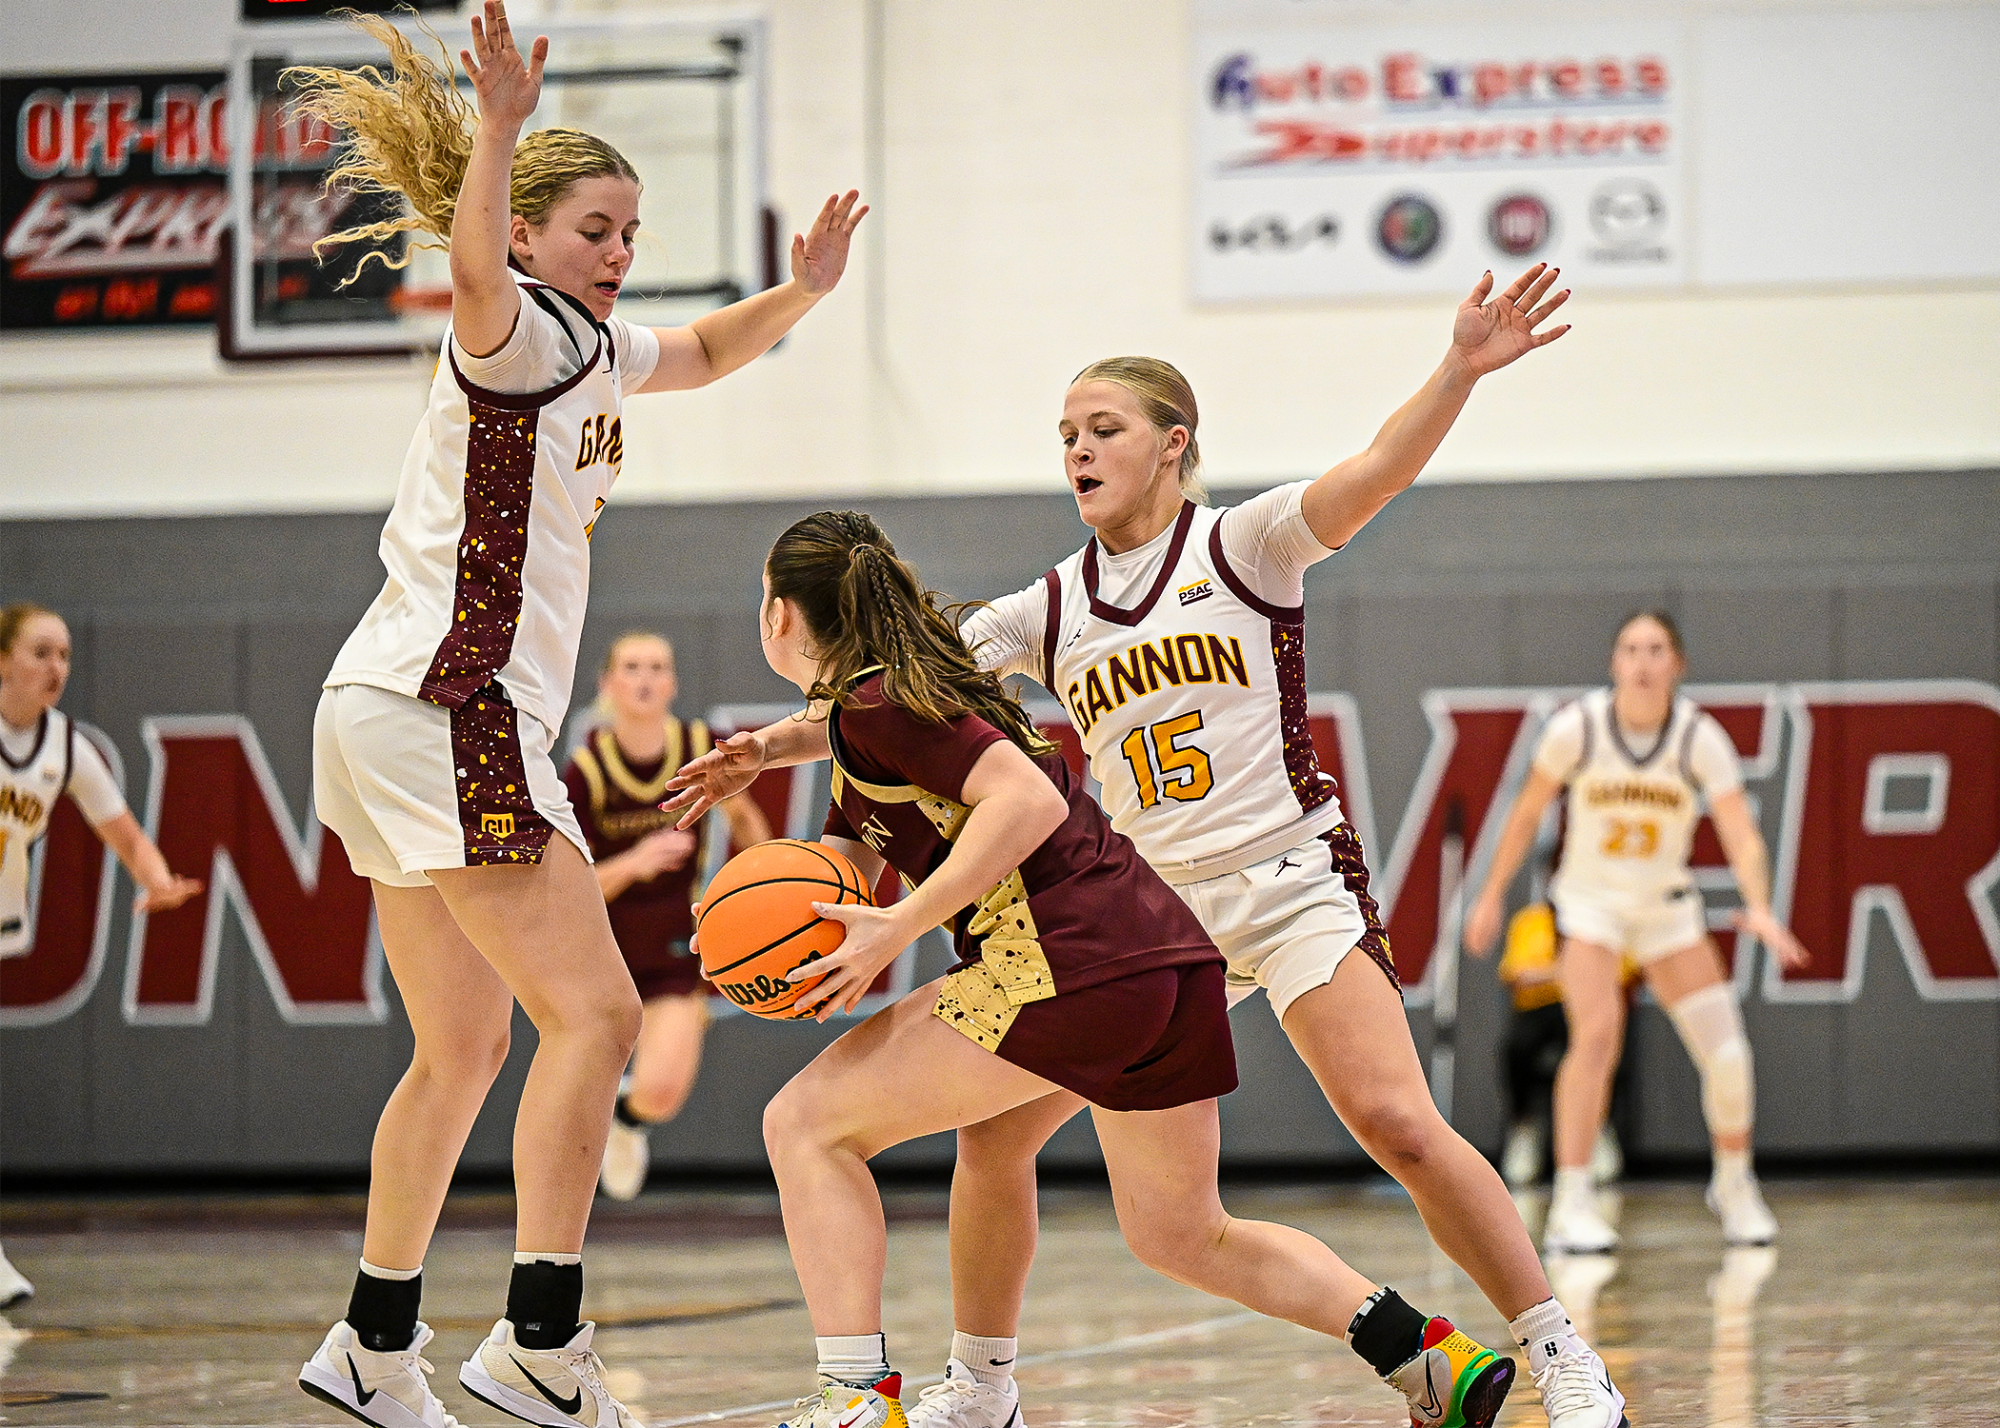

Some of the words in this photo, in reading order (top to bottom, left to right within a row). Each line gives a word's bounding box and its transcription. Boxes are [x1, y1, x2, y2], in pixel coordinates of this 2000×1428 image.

[1178, 581, 1214, 602] PSAC
[1068, 633, 1252, 738] GANNON
[1121, 709, 1215, 810] 15
[1601, 817, 1661, 859] 23
[719, 949, 823, 1006] Wils
